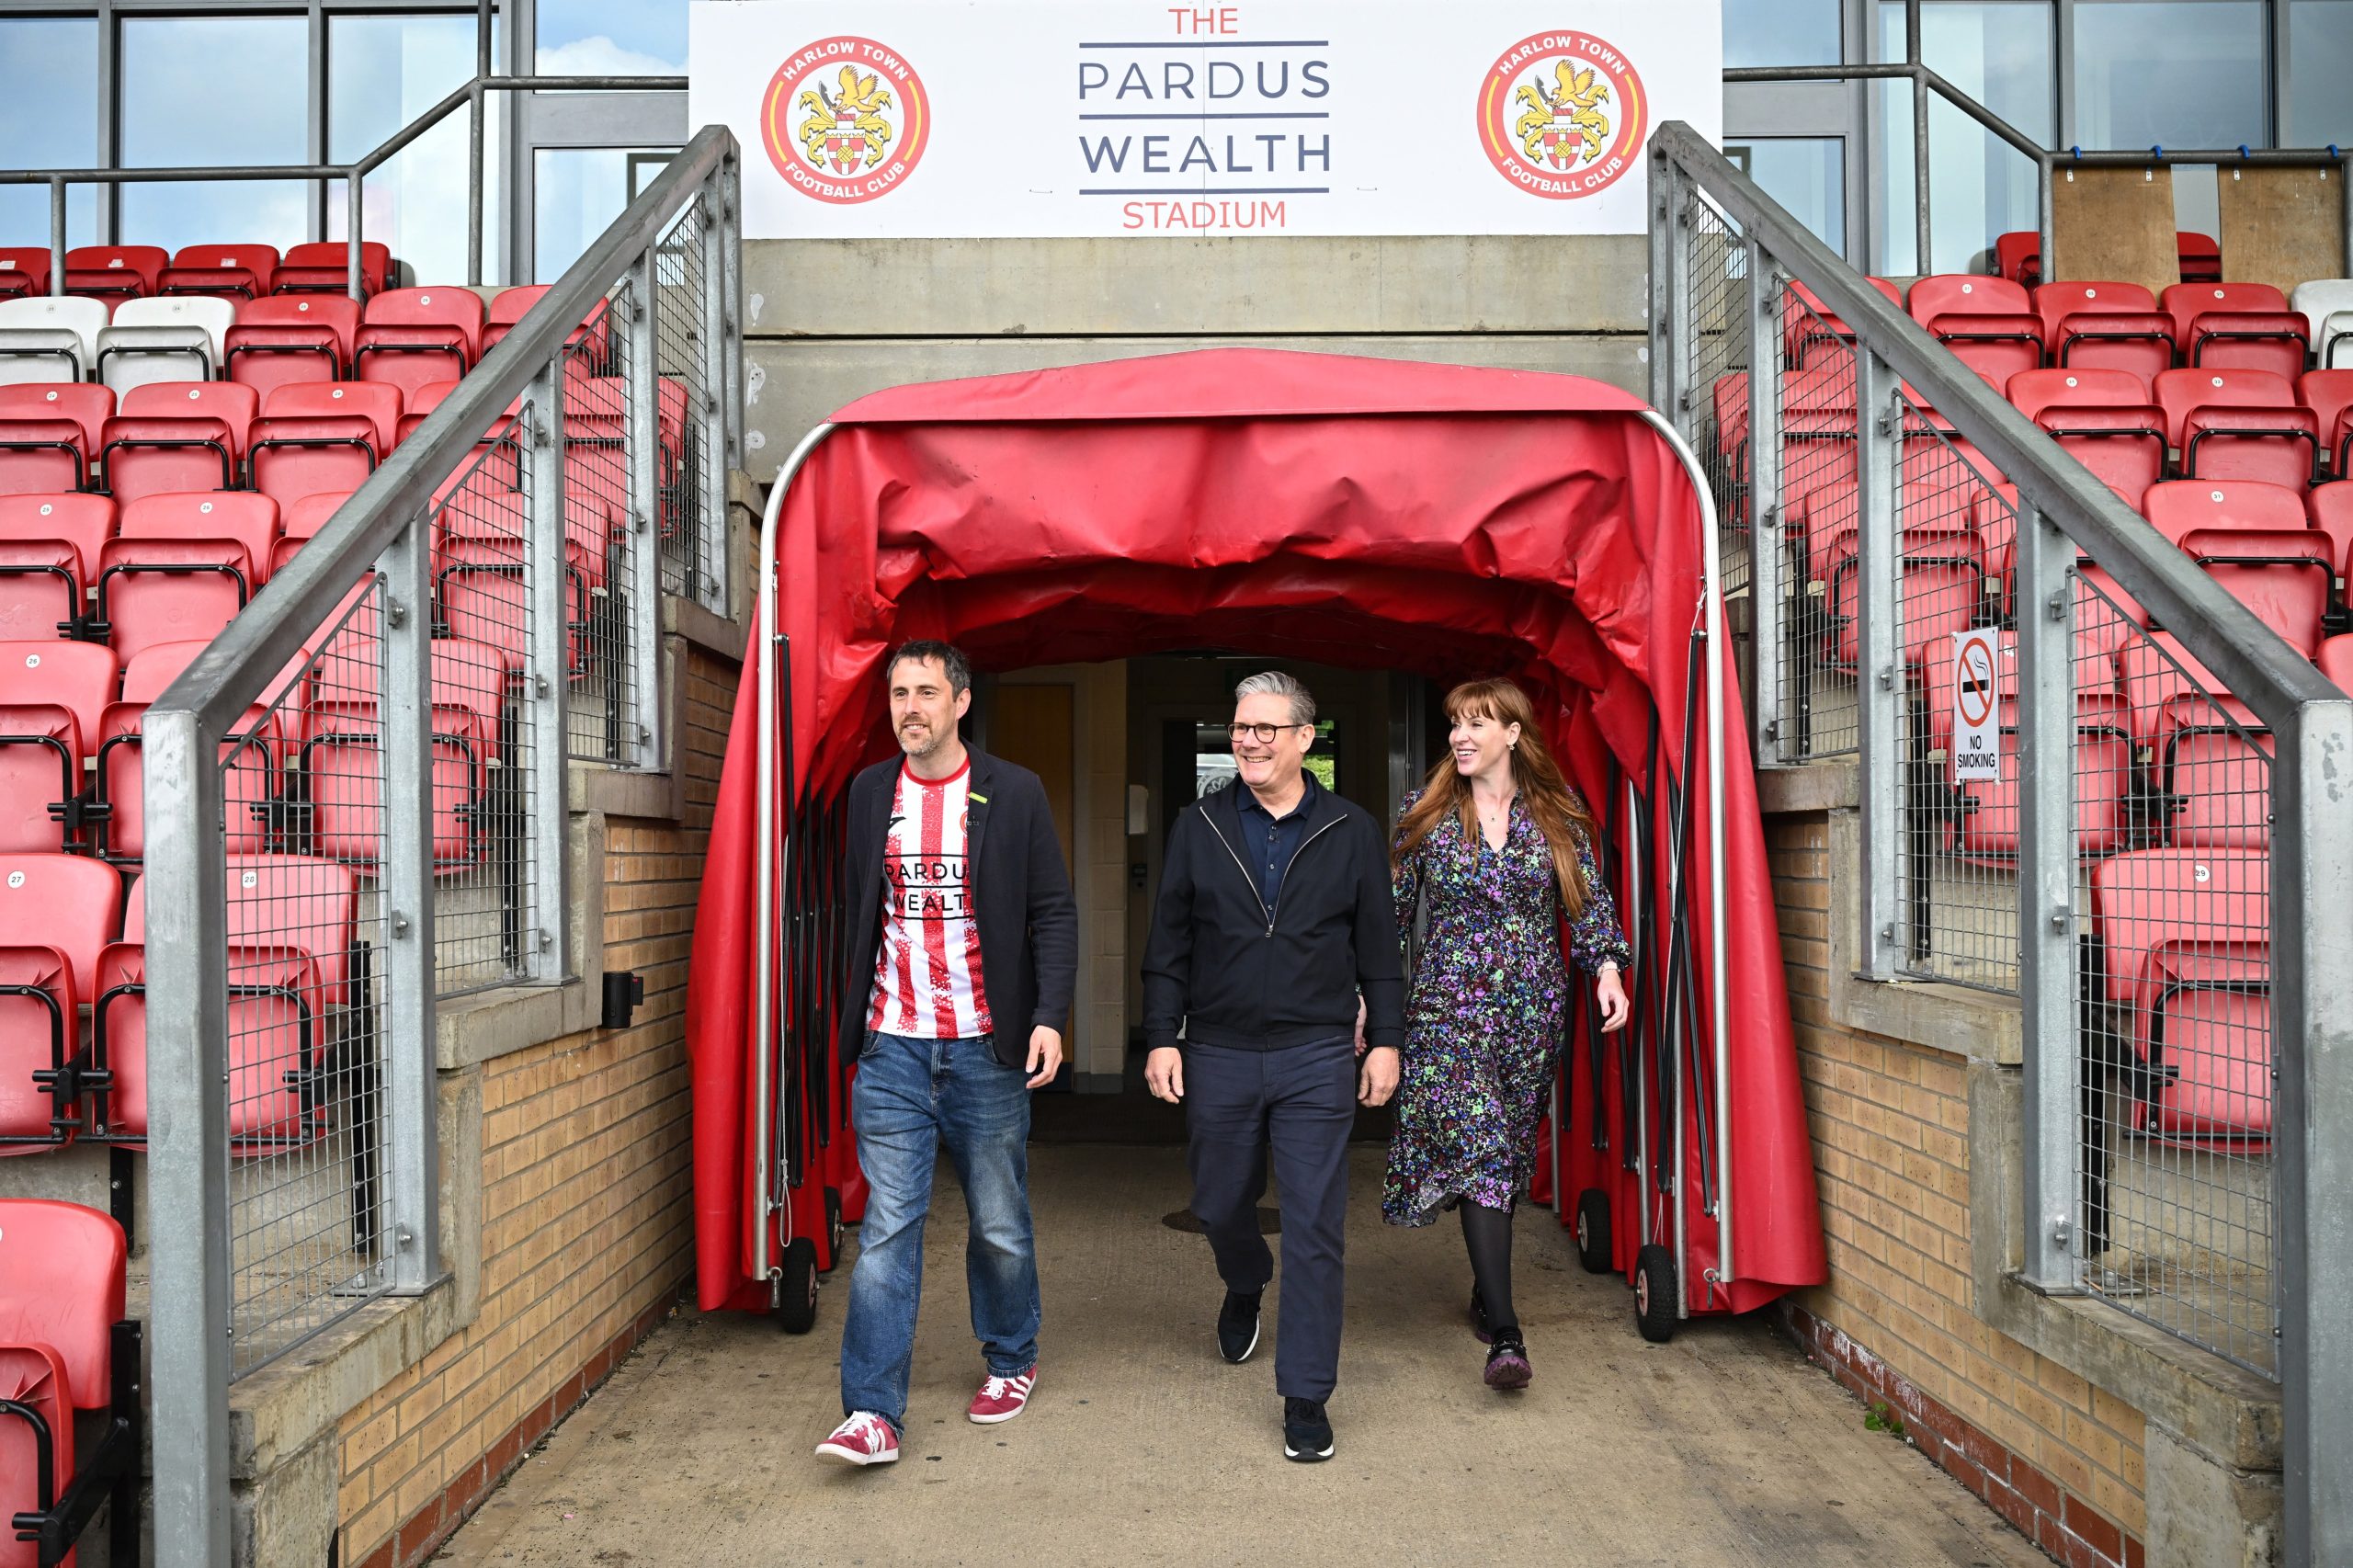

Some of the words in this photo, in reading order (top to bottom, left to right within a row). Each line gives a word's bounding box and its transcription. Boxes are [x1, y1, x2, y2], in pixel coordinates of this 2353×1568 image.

[1168, 8, 1238, 34] THE
[783, 41, 855, 80] HARLOW
[863, 44, 909, 80] TOWN
[1498, 36, 1571, 74] HARLOW
[1579, 39, 1626, 74] TOWN
[1079, 60, 1330, 99] PARDUS
[1079, 134, 1330, 173] WEALTH
[785, 162, 864, 198] FOOTBALL
[867, 162, 905, 192] CLUB
[1502, 156, 1582, 193] FOOTBALL
[1585, 156, 1623, 188] CLUB
[1122, 201, 1286, 228] STADIUM
[1958, 752, 1995, 768] SMOKING
[1970, 734, 1982, 750] NO
